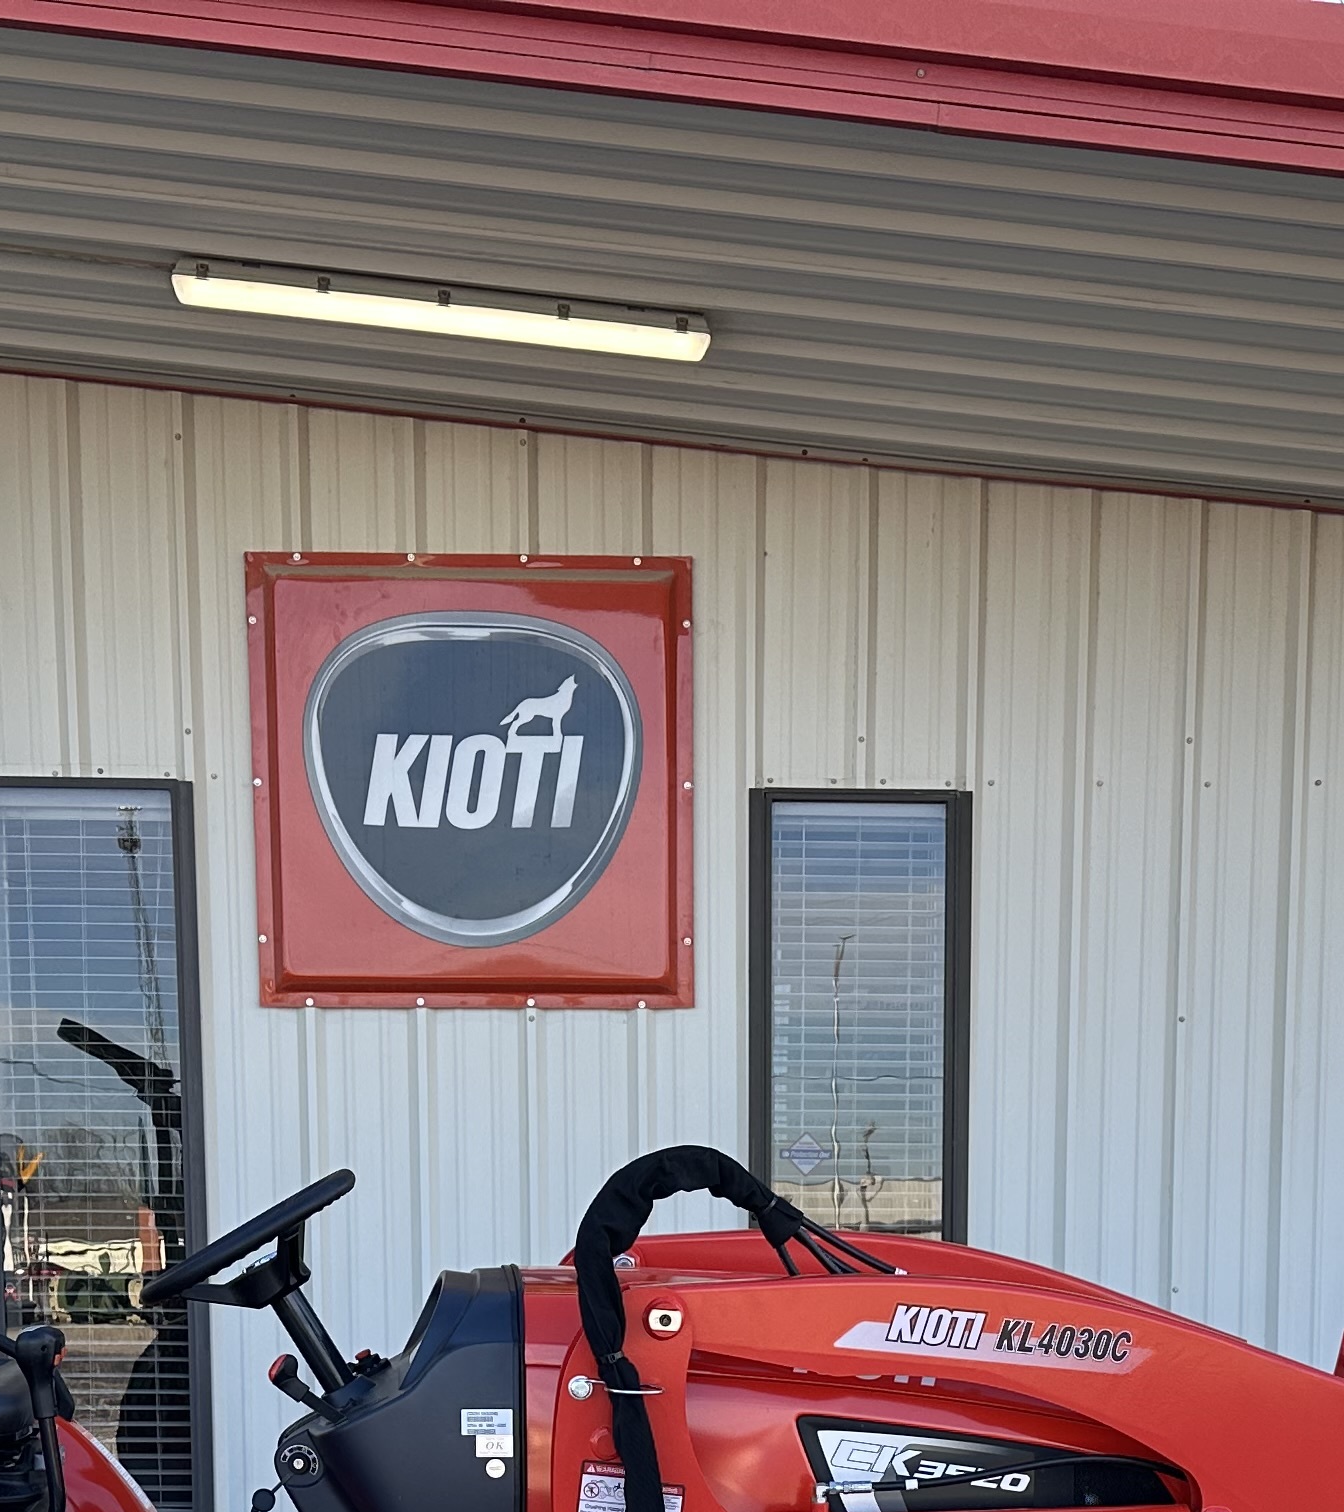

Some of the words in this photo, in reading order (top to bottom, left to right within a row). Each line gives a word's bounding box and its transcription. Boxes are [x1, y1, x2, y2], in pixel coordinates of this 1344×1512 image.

[363, 733, 584, 830] KIOTI
[885, 1303, 988, 1350] KIOTI
[994, 1318, 1132, 1363] KL4030C
